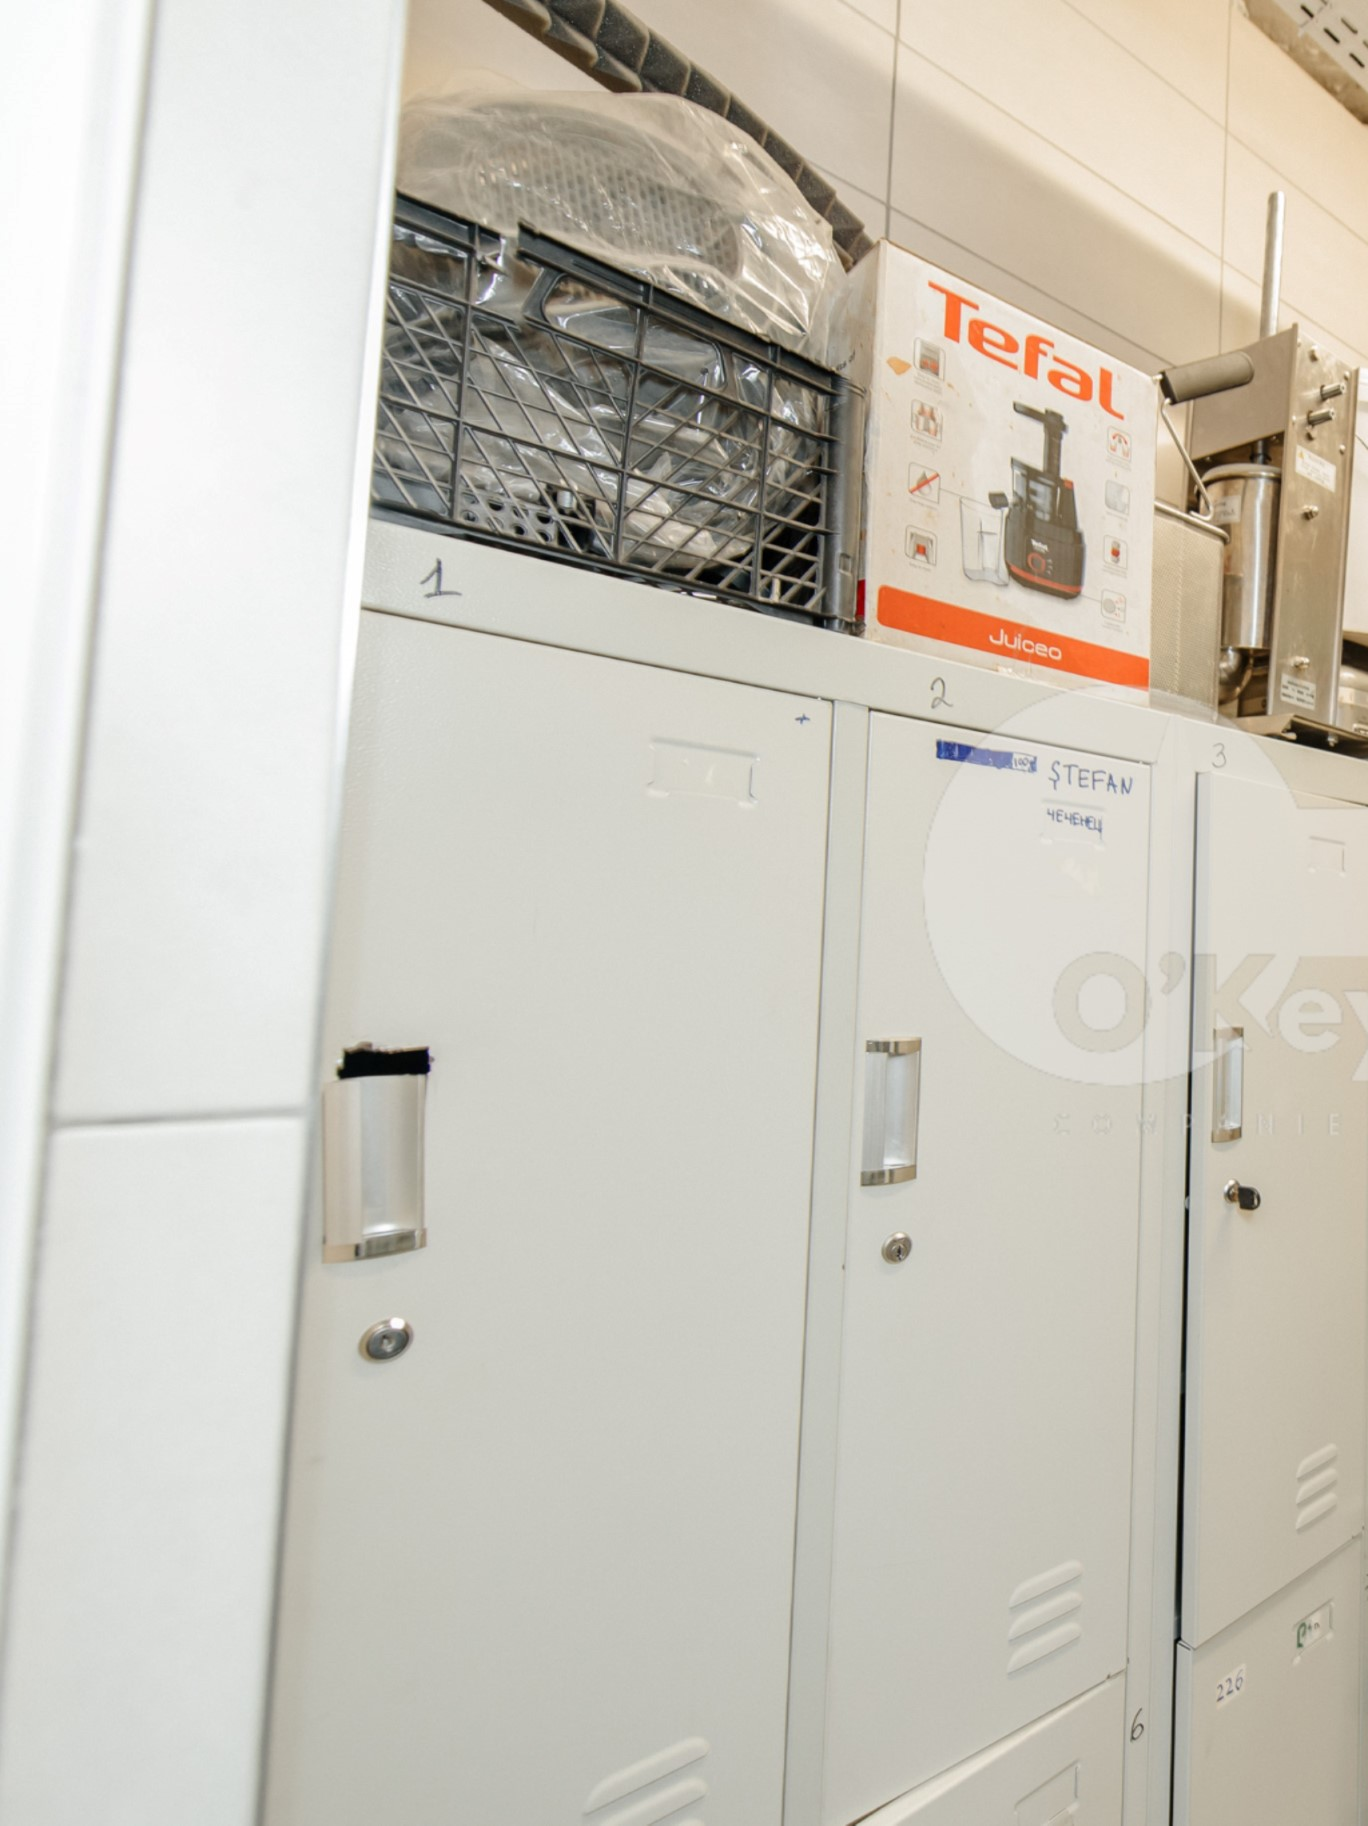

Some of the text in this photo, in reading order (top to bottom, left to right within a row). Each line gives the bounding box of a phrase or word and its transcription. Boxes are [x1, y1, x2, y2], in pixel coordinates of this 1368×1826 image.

[928, 281, 1124, 420] Tefal
[420, 557, 462, 598] 1
[989, 628, 1062, 661] Juiceo
[930, 677, 953, 709] 2
[1211, 742, 1227, 769] 3
[1216, 1668, 1245, 1703] 226
[1130, 1707, 1145, 1743] 6
